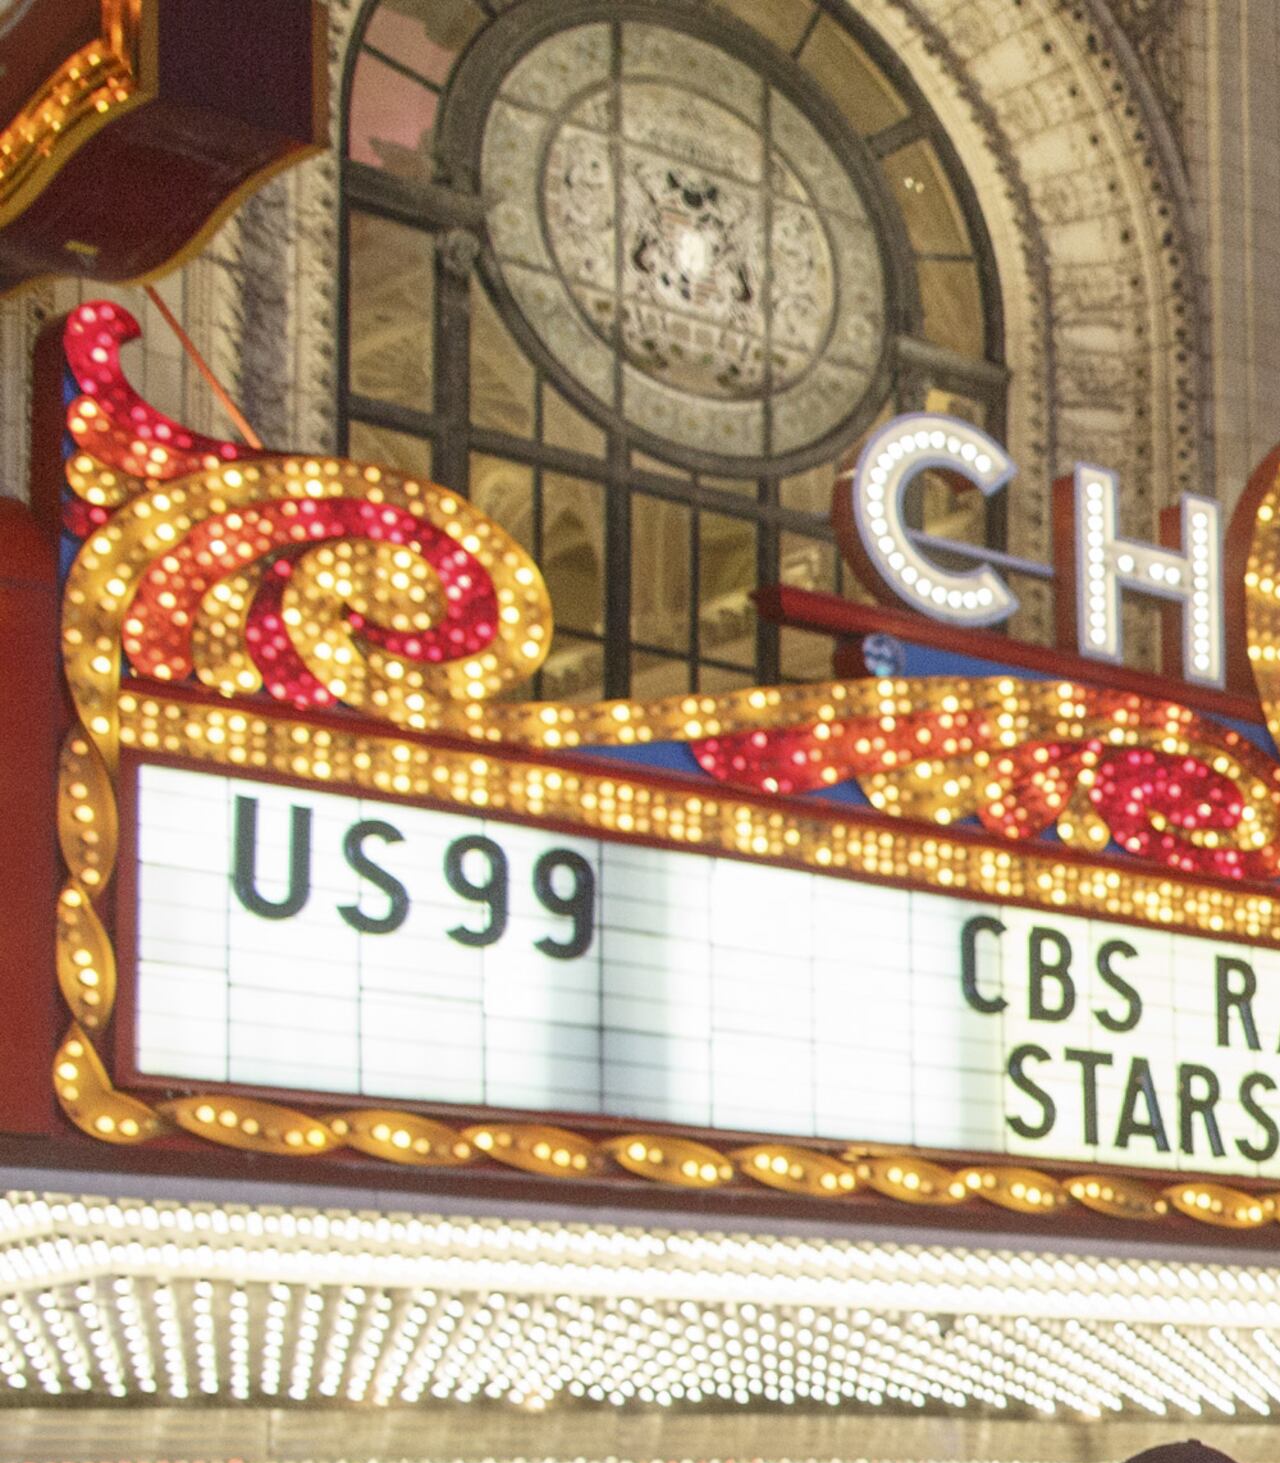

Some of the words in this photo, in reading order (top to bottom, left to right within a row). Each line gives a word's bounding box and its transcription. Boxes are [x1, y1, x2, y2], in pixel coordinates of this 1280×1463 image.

[233, 796, 597, 961] US99
[959, 913, 1143, 1034] CBS
[1006, 1044, 1280, 1163] STARS
